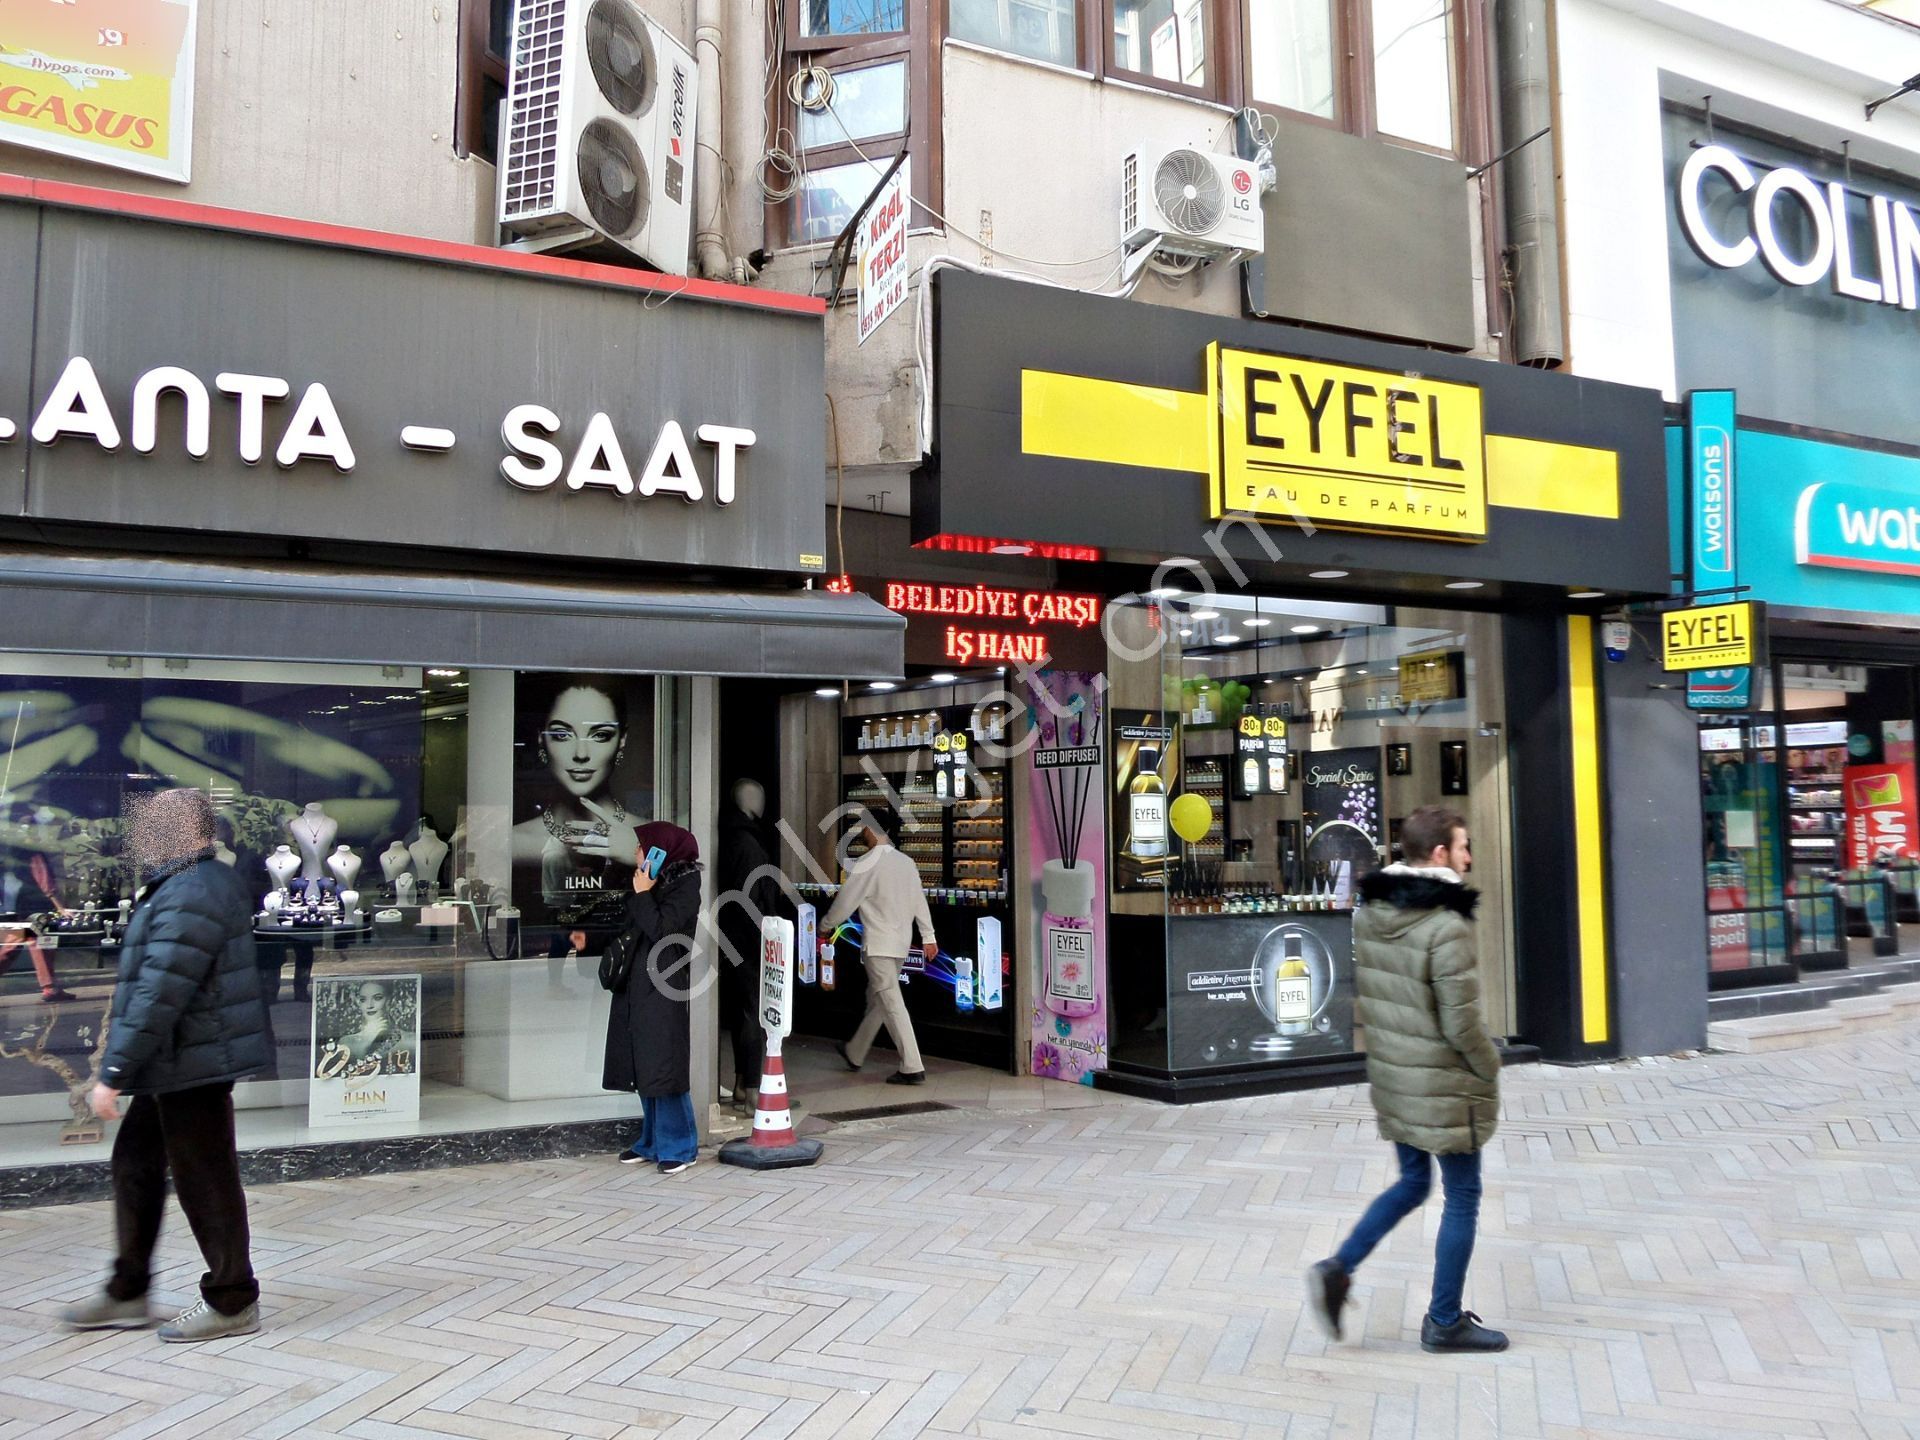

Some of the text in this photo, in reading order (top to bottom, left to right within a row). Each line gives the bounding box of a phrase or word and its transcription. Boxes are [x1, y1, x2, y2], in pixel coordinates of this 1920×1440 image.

[31, 57, 115, 78] flypgs.com
[0, 85, 159, 149] GASUS
[672, 64, 685, 137] arçelik
[870, 187, 904, 247] KRAL
[1233, 196, 1250, 211] LG
[869, 218, 905, 287] TERZİ
[0, 356, 355, 472] ANTA
[501, 404, 757, 506] SAAT
[1243, 366, 1465, 472] EYFEL
[1246, 485, 1468, 520] EAU DE PARFUM
[1704, 444, 1721, 553] watsons
[887, 583, 1097, 628] BELEDİYE ÇARŞI
[946, 626, 1046, 664] İŞ HANI
[1667, 614, 1745, 648] EYFEL
[1688, 695, 1748, 705] watsons
[1036, 748, 1099, 765] REED DIFFUSER
[1306, 764, 1376, 789] Special Series
[1135, 808, 1162, 820] EYFEL
[1057, 934, 1085, 951] EYFEL
[764, 965, 785, 985] PROTEZ
[1191, 975, 1223, 986] addictive
[1280, 990, 1306, 1002] EYFEL
